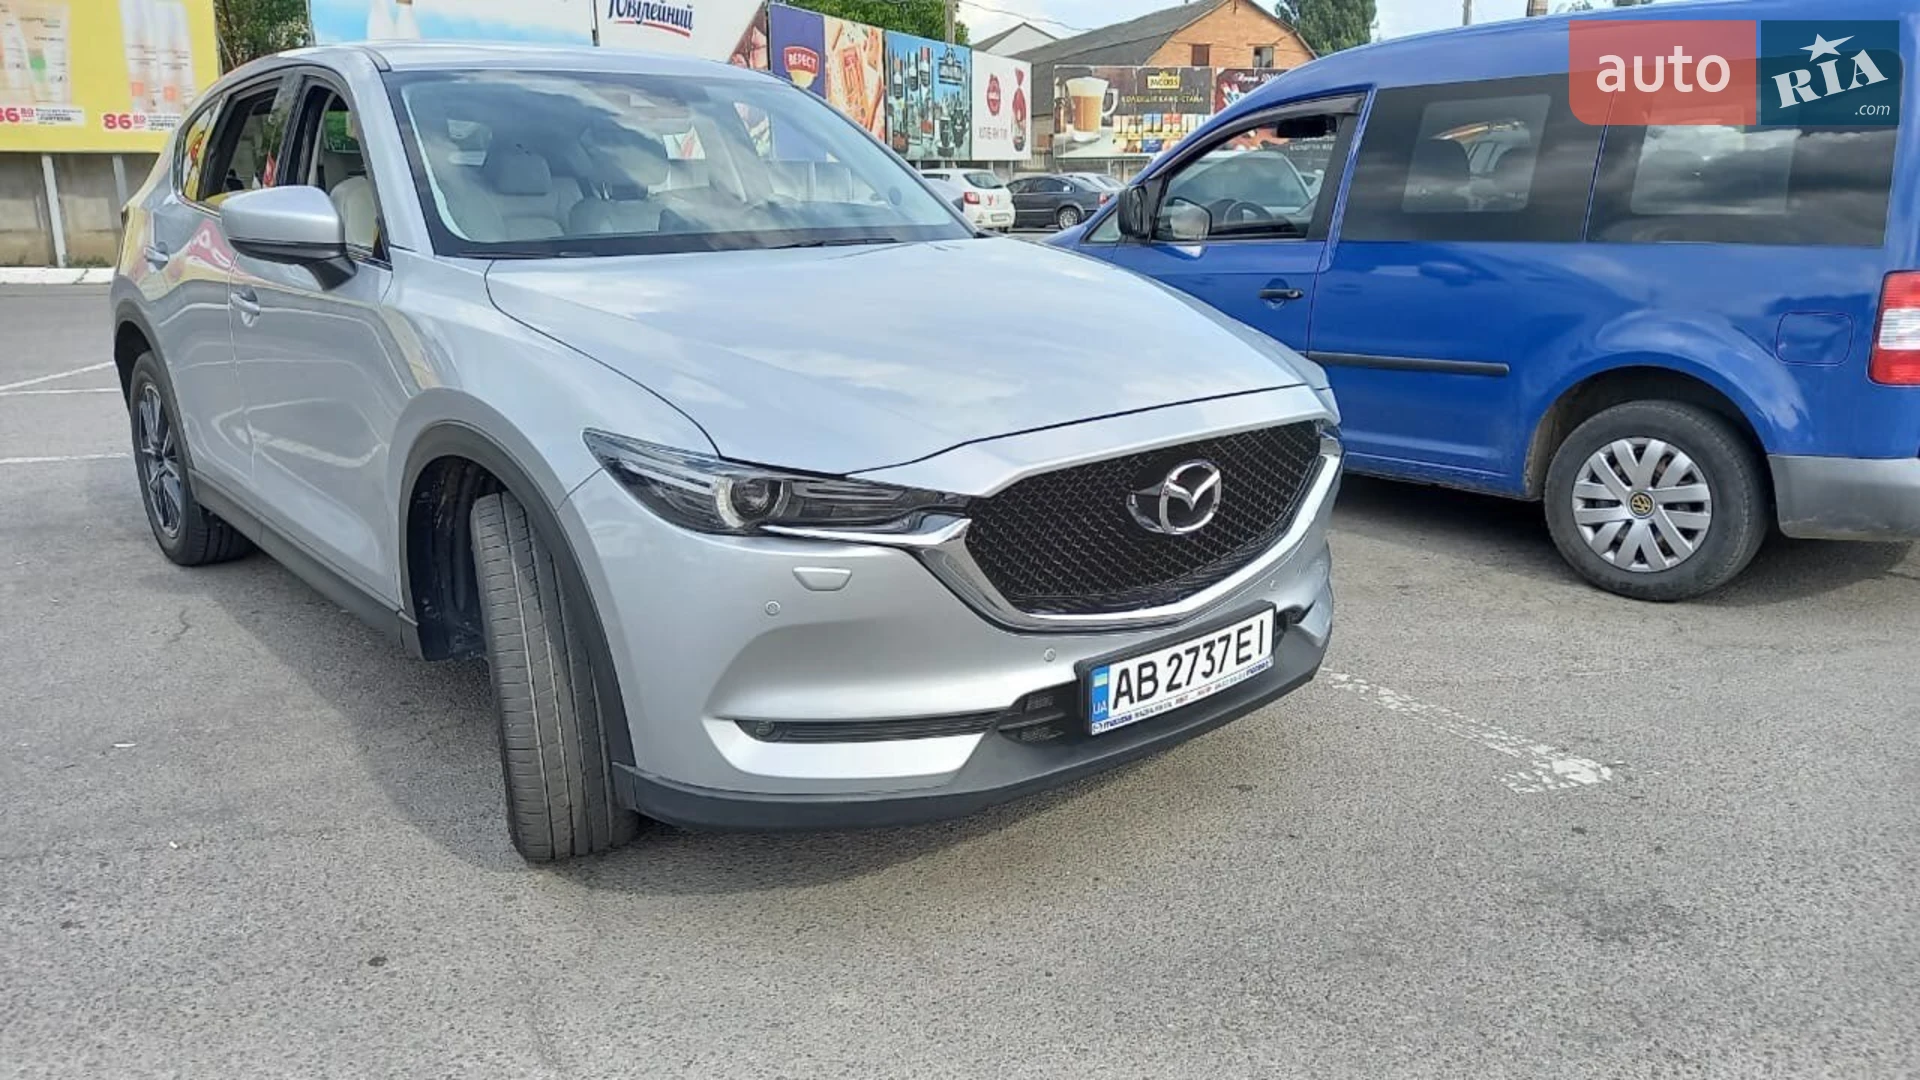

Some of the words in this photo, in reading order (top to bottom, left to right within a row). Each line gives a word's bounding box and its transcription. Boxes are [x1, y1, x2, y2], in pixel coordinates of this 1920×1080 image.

[103, 114, 132, 130] 86
[1113, 661, 1158, 709] AB
[1166, 634, 1231, 692] 2737
[1093, 702, 1107, 714] UA
